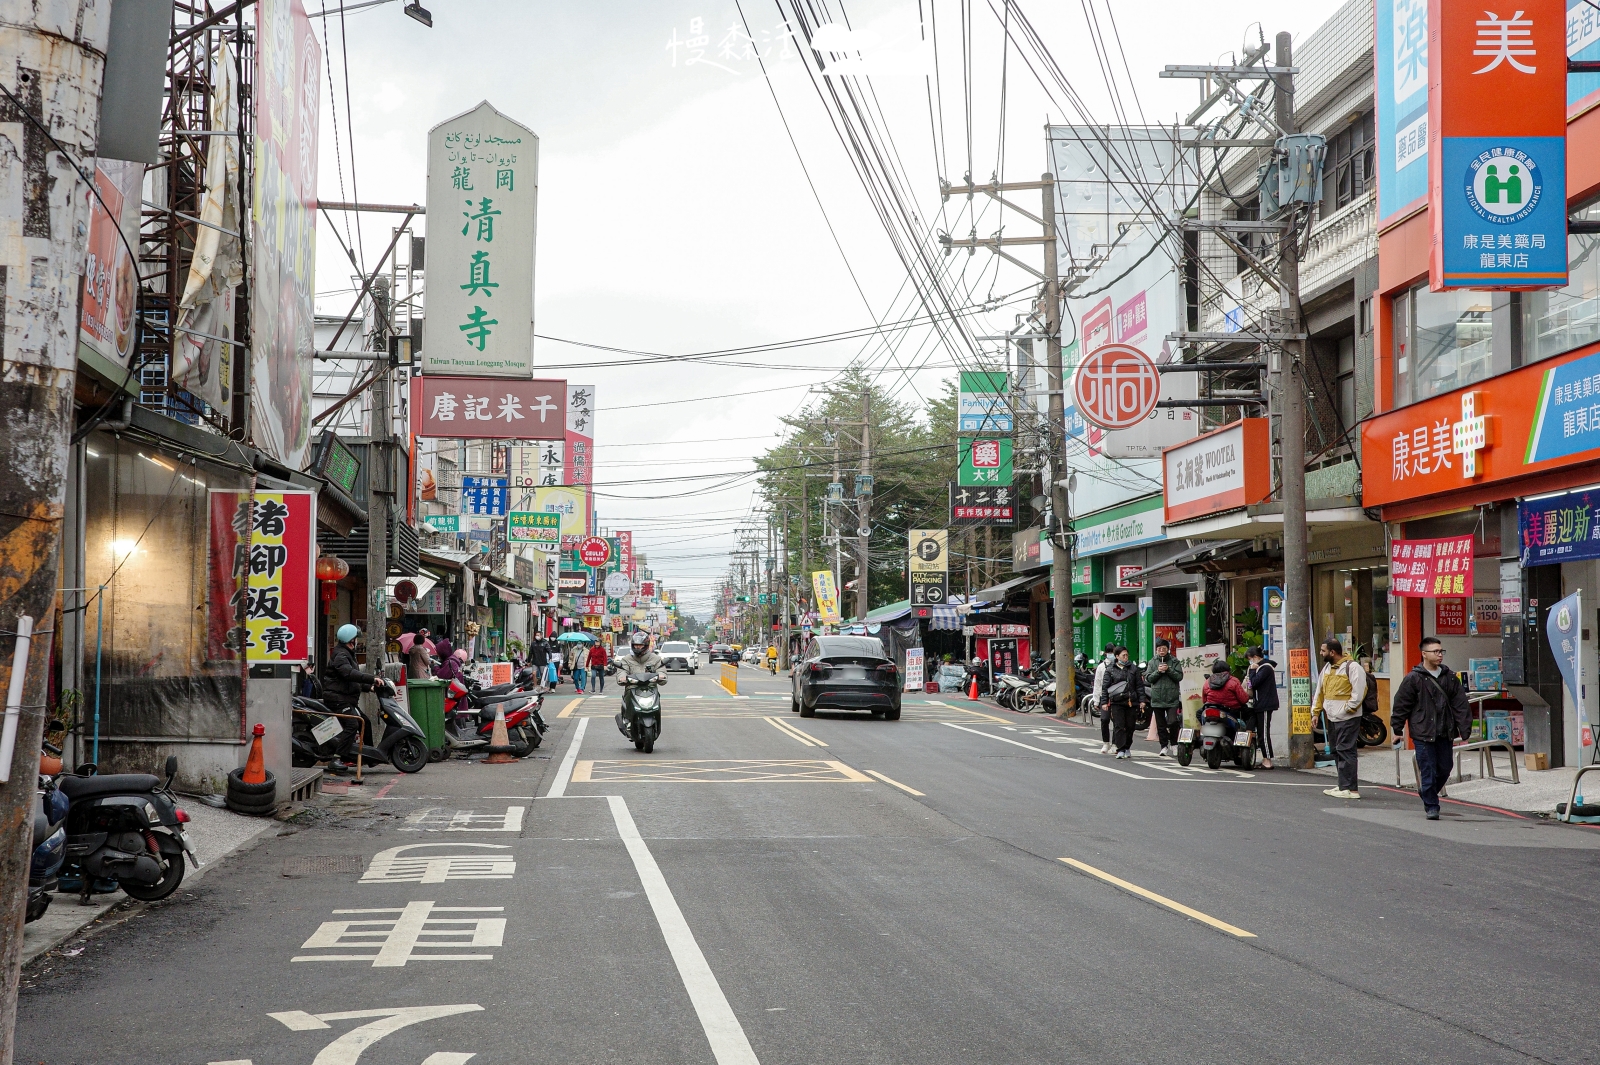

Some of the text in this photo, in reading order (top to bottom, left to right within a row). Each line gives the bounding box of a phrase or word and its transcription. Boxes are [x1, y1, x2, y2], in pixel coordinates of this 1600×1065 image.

[1567, 2, 1600, 47] 生活
[1471, 10, 1537, 75] 美
[484, 134, 522, 146] مسجد
[1470, 147, 1537, 171] 全民健康保險
[450, 166, 514, 192] 龍岡
[1466, 185, 1542, 224] NATIONAL HEALTH INSURANCE
[1463, 234, 1546, 250] 康是美藥局
[459, 197, 501, 352] 清真寺
[1479, 252, 1529, 269] 龍東店
[429, 357, 526, 368] Taiwan Taoyuan Longgang Mosque
[1554, 373, 1600, 406] 康是美藥局
[1563, 402, 1600, 439] 龍東店
[1205, 444, 1236, 470] WOOTEA
[1392, 417, 1452, 481] 康是美
[574, 442, 586, 486] 過橋米
[973, 468, 1000, 482] 大樹
[1529, 504, 1590, 548] 美麗迎新
[582, 538, 608, 551] WARUNG
[620, 544, 629, 577] 大同家
[1114, 624, 1122, 641] 處方
